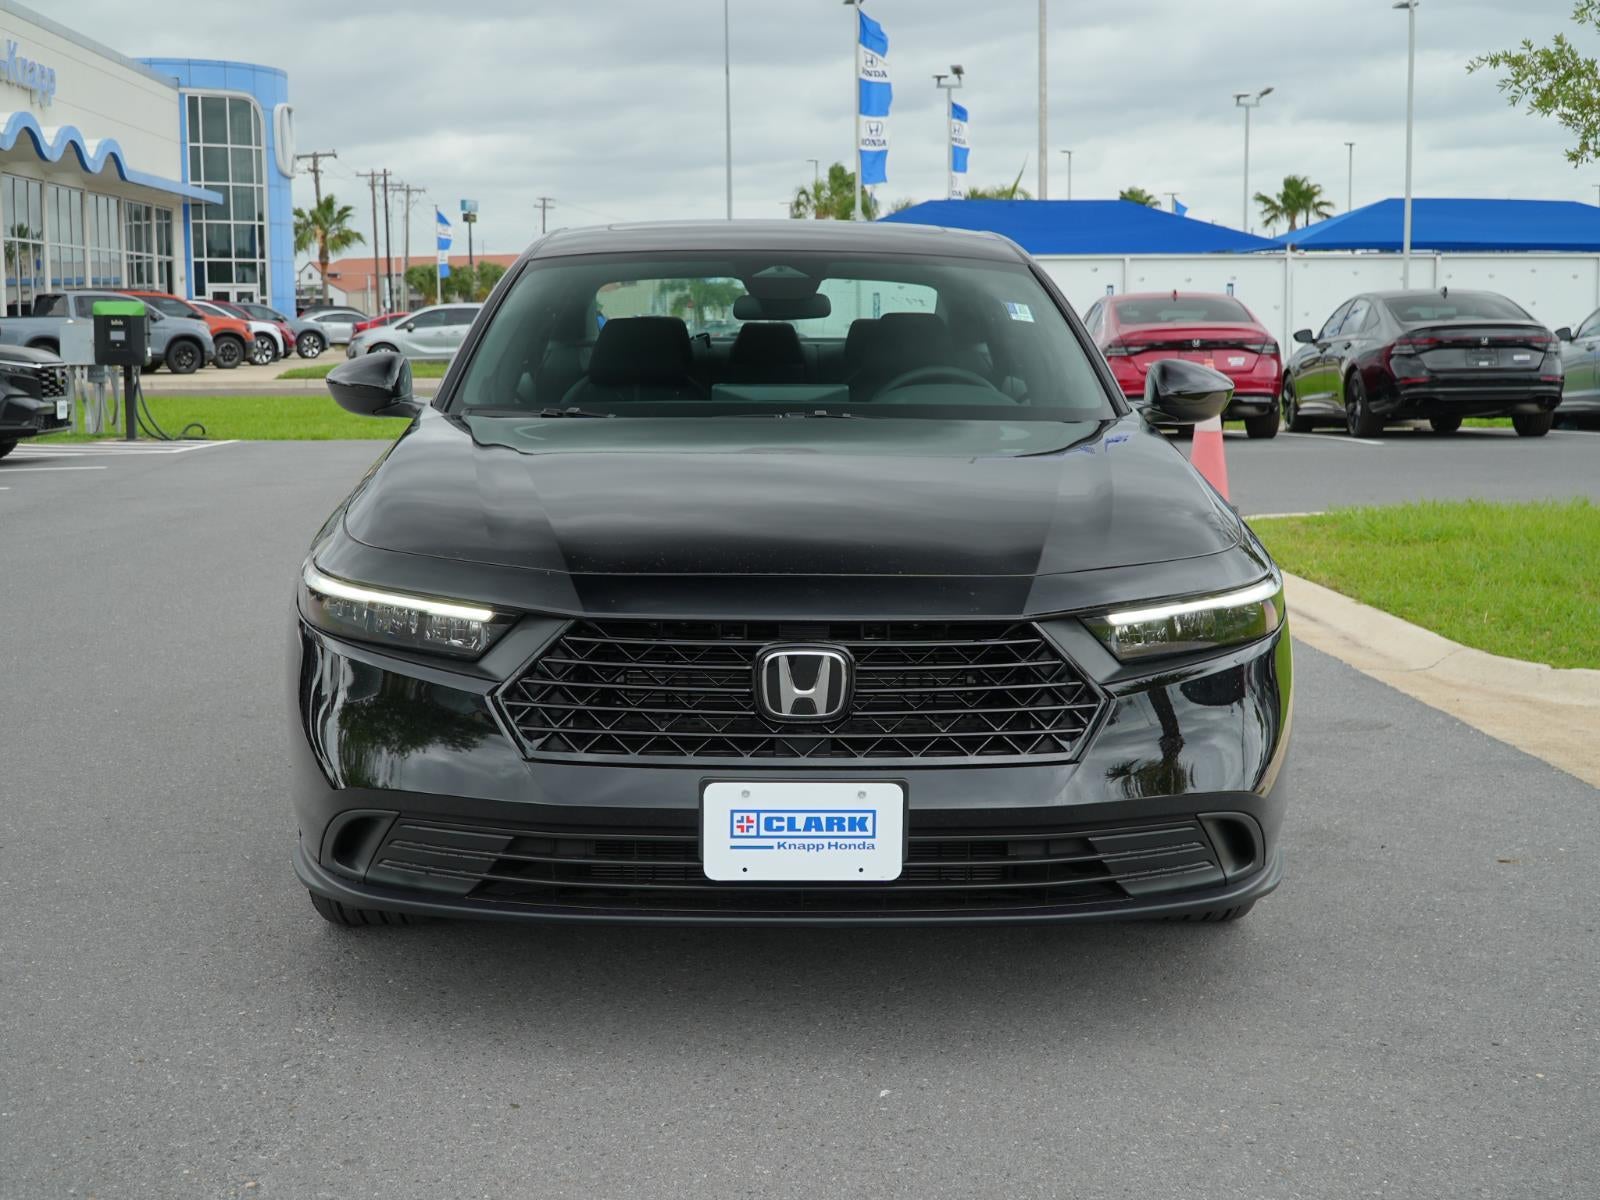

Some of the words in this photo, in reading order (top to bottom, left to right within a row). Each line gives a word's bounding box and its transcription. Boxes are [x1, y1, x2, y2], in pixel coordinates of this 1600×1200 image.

[7, 39, 56, 107] Knapp
[764, 816, 869, 832] CLARK
[777, 841, 825, 852] Knapp
[828, 841, 876, 850] Honda
